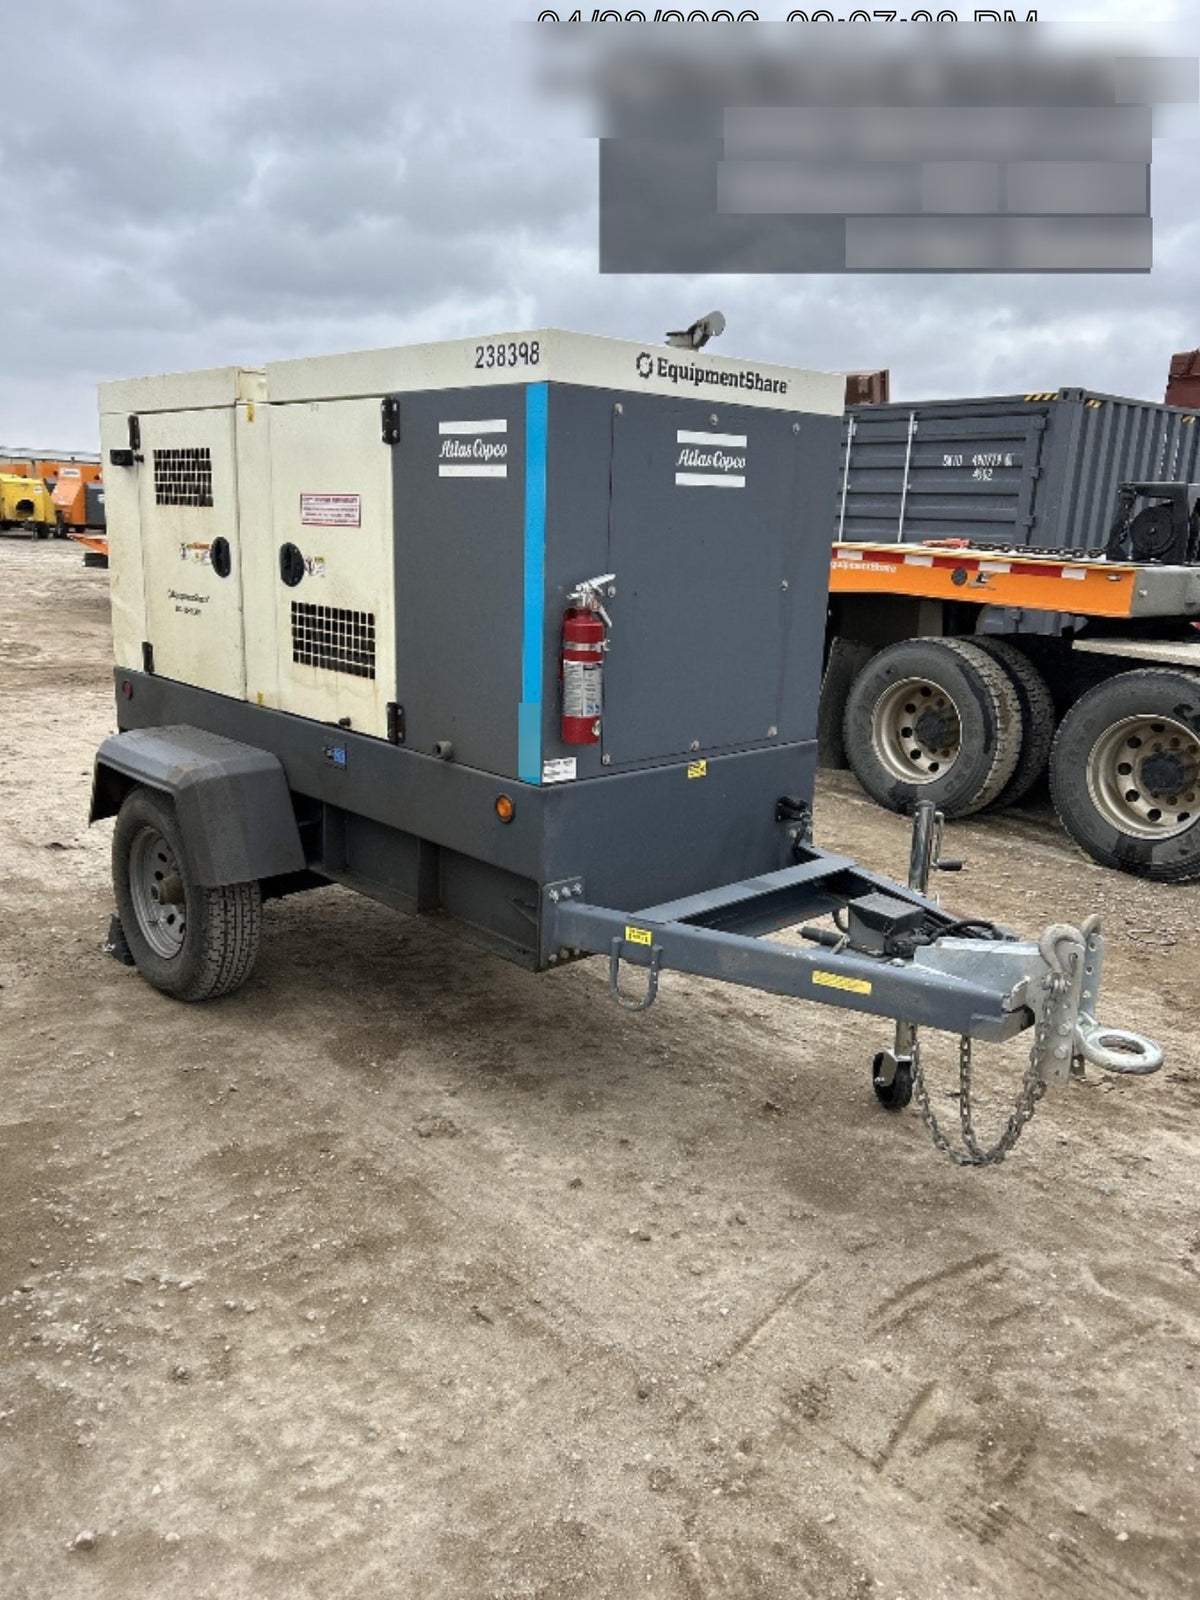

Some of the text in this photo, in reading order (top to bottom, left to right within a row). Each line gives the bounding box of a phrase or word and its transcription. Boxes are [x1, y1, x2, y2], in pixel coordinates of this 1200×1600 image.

[474, 341, 540, 368] 238398
[657, 356, 788, 394] EquipmentShare
[439, 438, 508, 461] Atlas Copco
[676, 449, 746, 472] Atlas Copco
